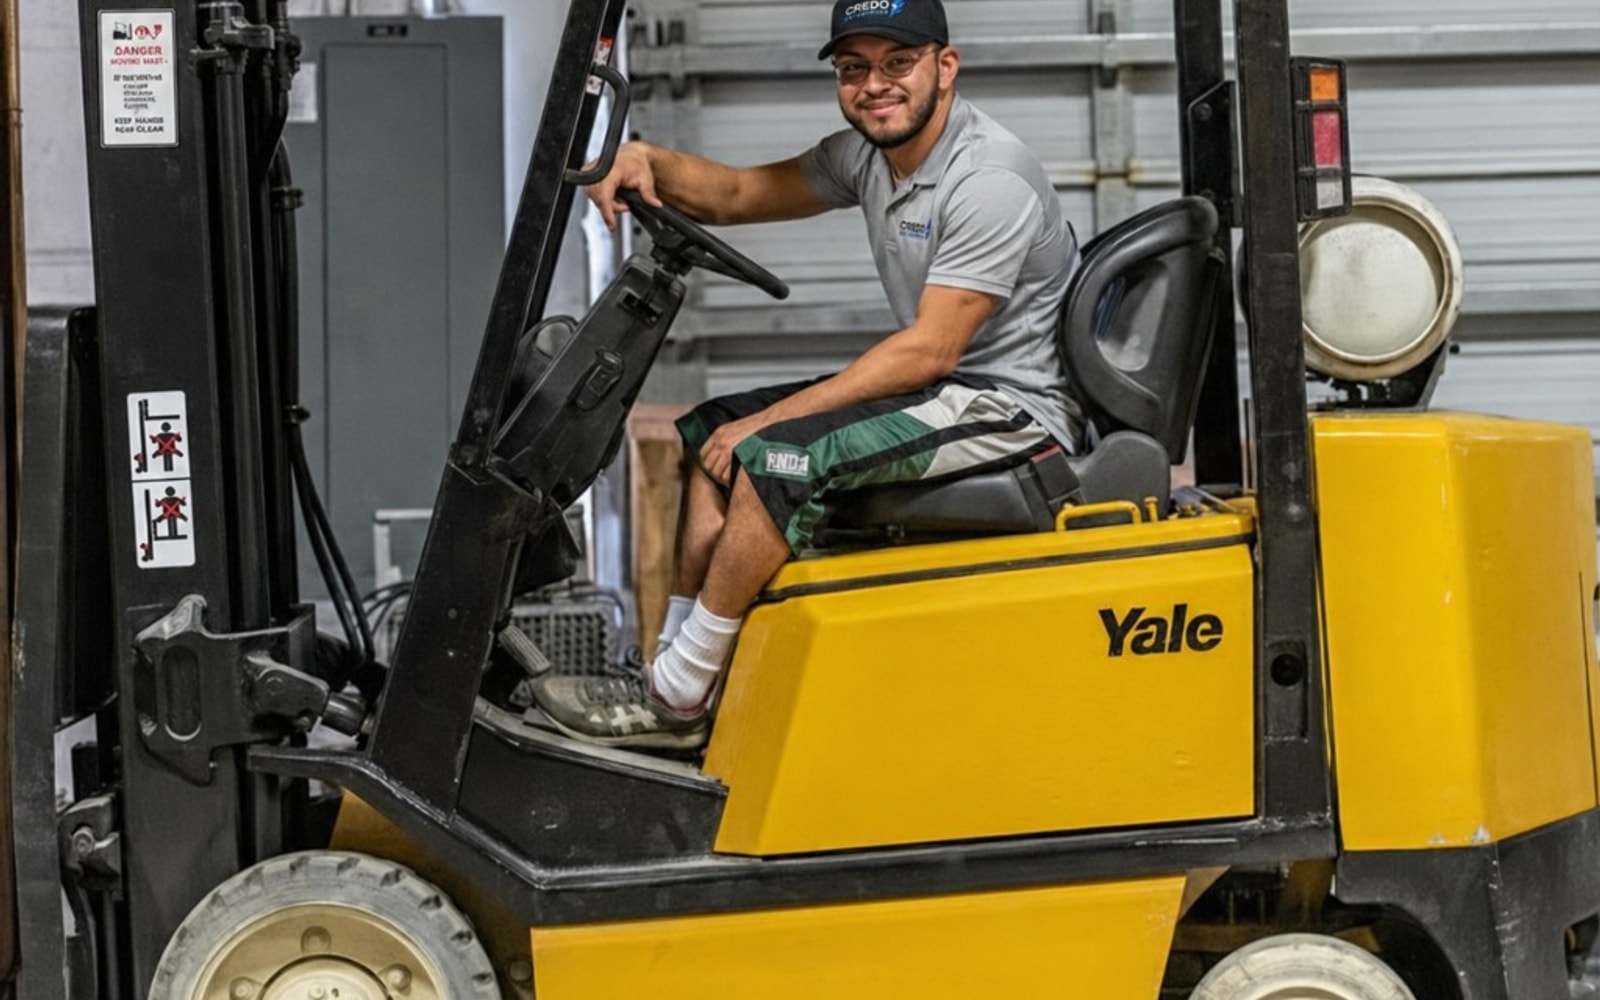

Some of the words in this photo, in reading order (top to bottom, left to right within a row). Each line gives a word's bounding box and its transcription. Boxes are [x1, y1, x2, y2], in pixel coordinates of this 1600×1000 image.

[845, 0, 890, 15] CREDO
[114, 46, 162, 55] DANGER
[136, 125, 164, 133] CLEAR
[1098, 603, 1223, 657] Yale
